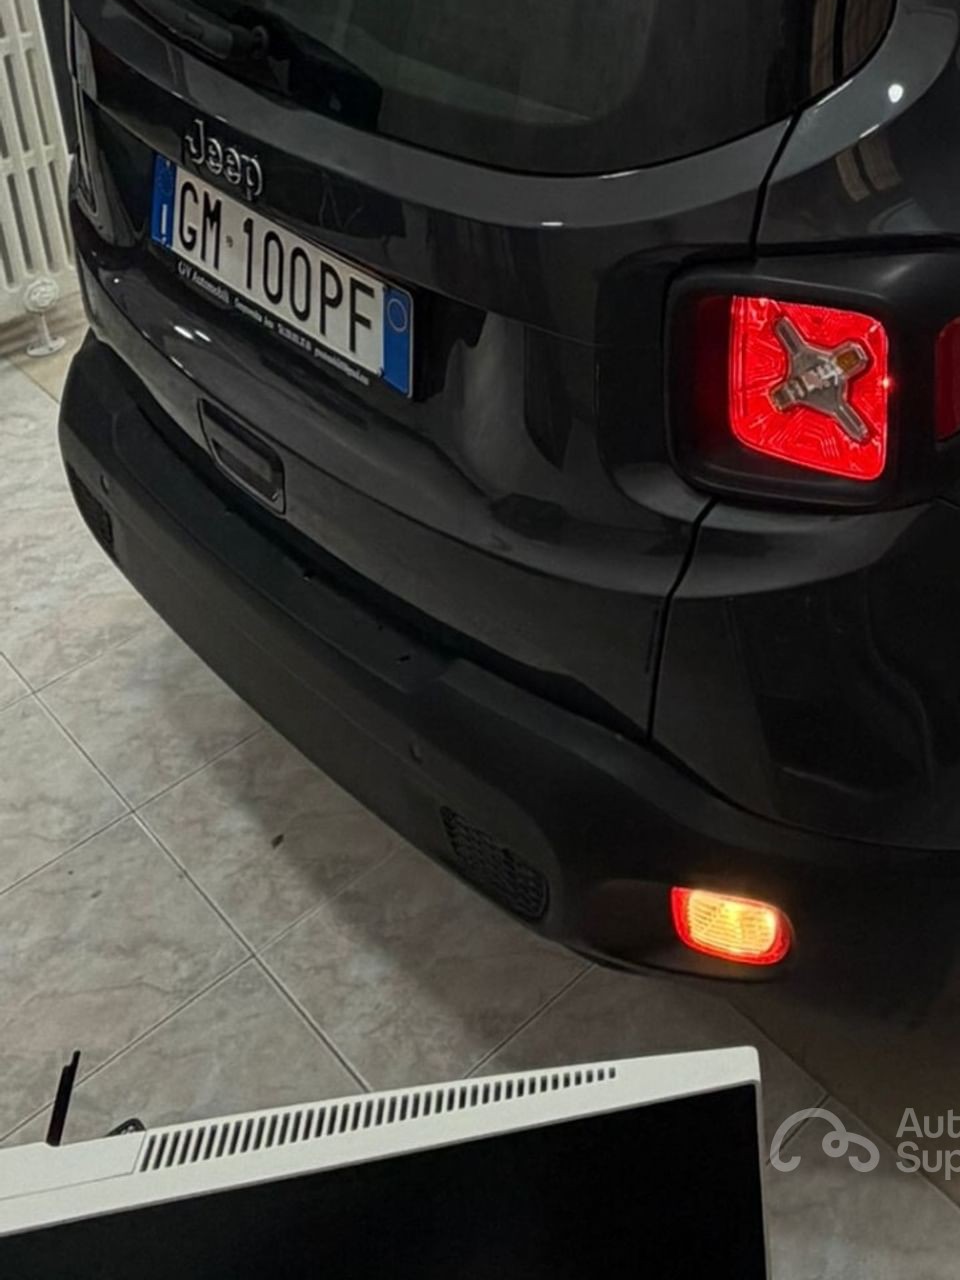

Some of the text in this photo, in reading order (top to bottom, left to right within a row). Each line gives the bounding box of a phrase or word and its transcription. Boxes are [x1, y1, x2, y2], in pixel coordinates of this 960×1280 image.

[184, 119, 264, 202] Jeep
[178, 181, 222, 270] GM
[242, 218, 375, 355] 100PF
